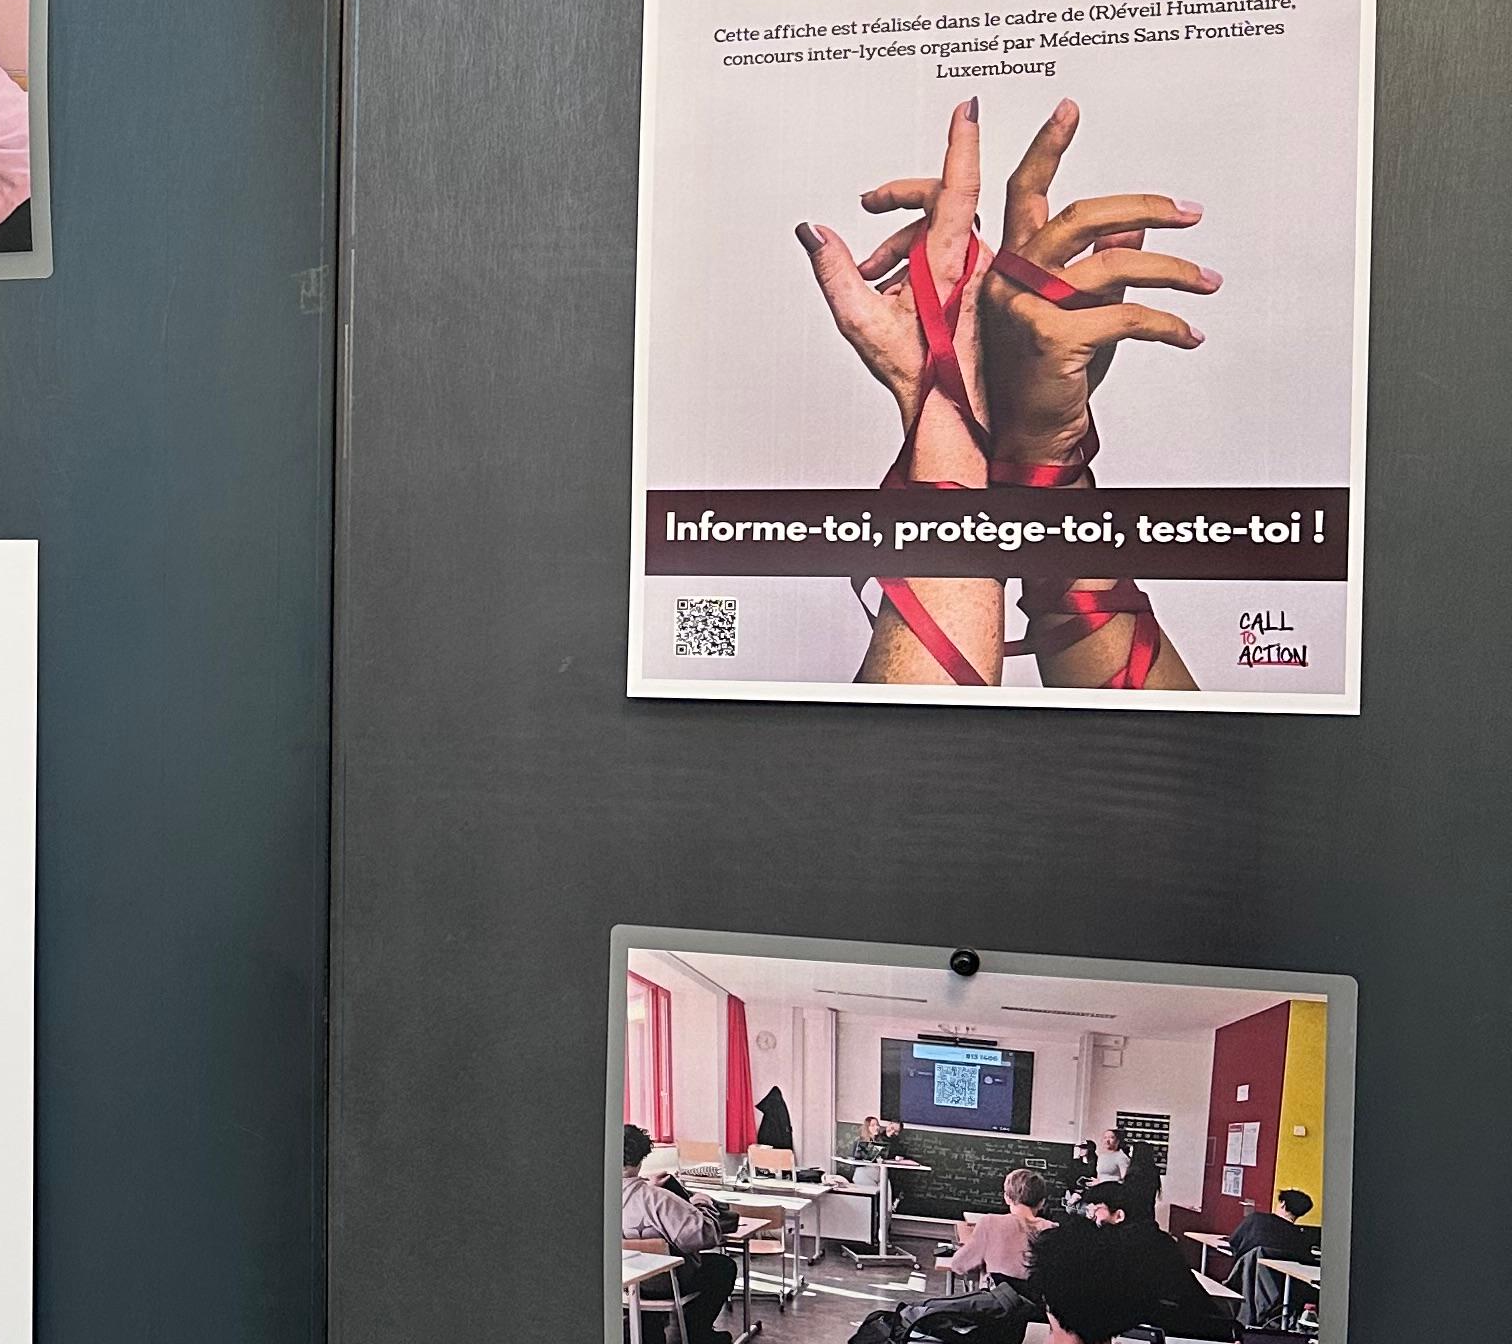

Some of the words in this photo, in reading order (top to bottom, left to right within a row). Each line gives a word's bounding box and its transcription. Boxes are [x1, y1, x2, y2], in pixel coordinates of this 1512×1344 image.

[714, 27, 759, 43] Cette
[763, 23, 827, 40] affiche
[831, 21, 857, 36] est
[862, 15, 932, 34] réalisée
[935, 14, 980, 30] dans
[984, 12, 1001, 27] le
[1004, 8, 1057, 27] cadre
[1061, 6, 1084, 22] de
[1089, 1, 1162, 21] (R)éveil
[723, 50, 803, 67] concours
[807, 39, 916, 62] inter-lycées
[920, 35, 999, 57] organisé
[1003, 37, 1036, 54] par
[1040, 29, 1130, 48] Médecins
[1134, 26, 1180, 43] Sans
[1184, 20, 1285, 40] Frontières
[936, 59, 1056, 79] Luxembourg
[665, 511, 884, 548] Informe-toi,
[893, 511, 1125, 551] protège-toi,
[1137, 511, 1302, 544] teste-toi
[1239, 610, 1294, 635] CALL
[1240, 630, 1257, 645] TO
[1238, 643, 1307, 668] ACTION
